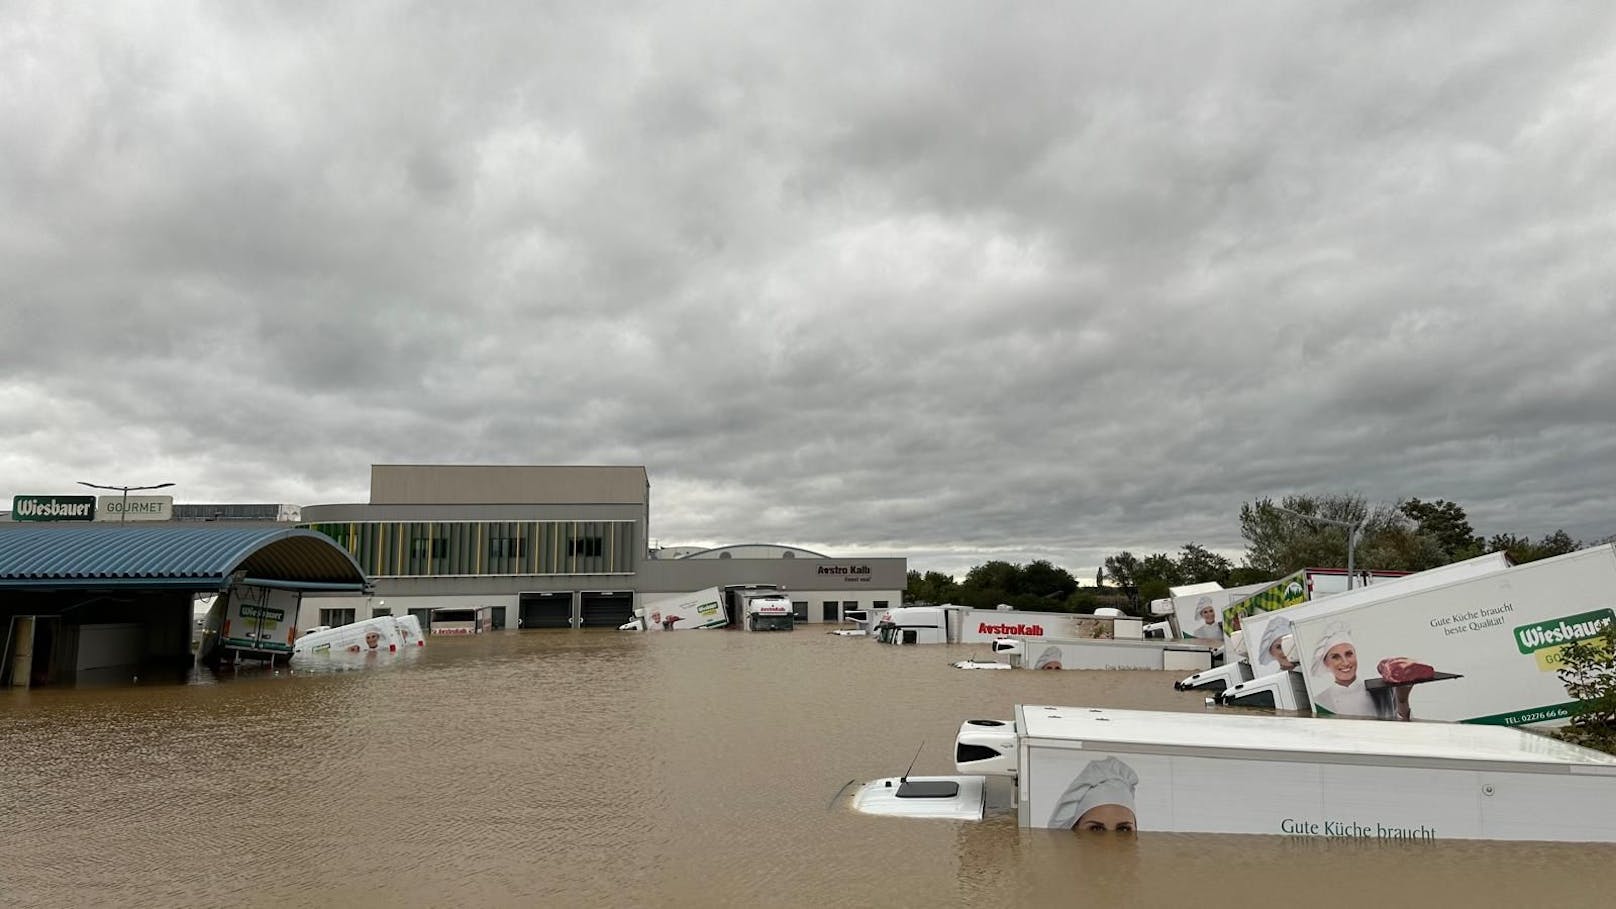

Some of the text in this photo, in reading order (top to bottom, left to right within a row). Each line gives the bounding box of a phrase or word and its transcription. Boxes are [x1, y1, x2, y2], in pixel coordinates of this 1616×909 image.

[17, 500, 91, 516] Wiesbauer
[107, 503, 164, 512] GOURMET
[1430, 616, 1451, 628] Gute
[1480, 602, 1513, 617] braucht
[1444, 625, 1468, 636] beste
[1505, 717, 1520, 725] TEL:
[1521, 712, 1546, 721] 02276
[1281, 819, 1436, 840] Gute Küche braucht
